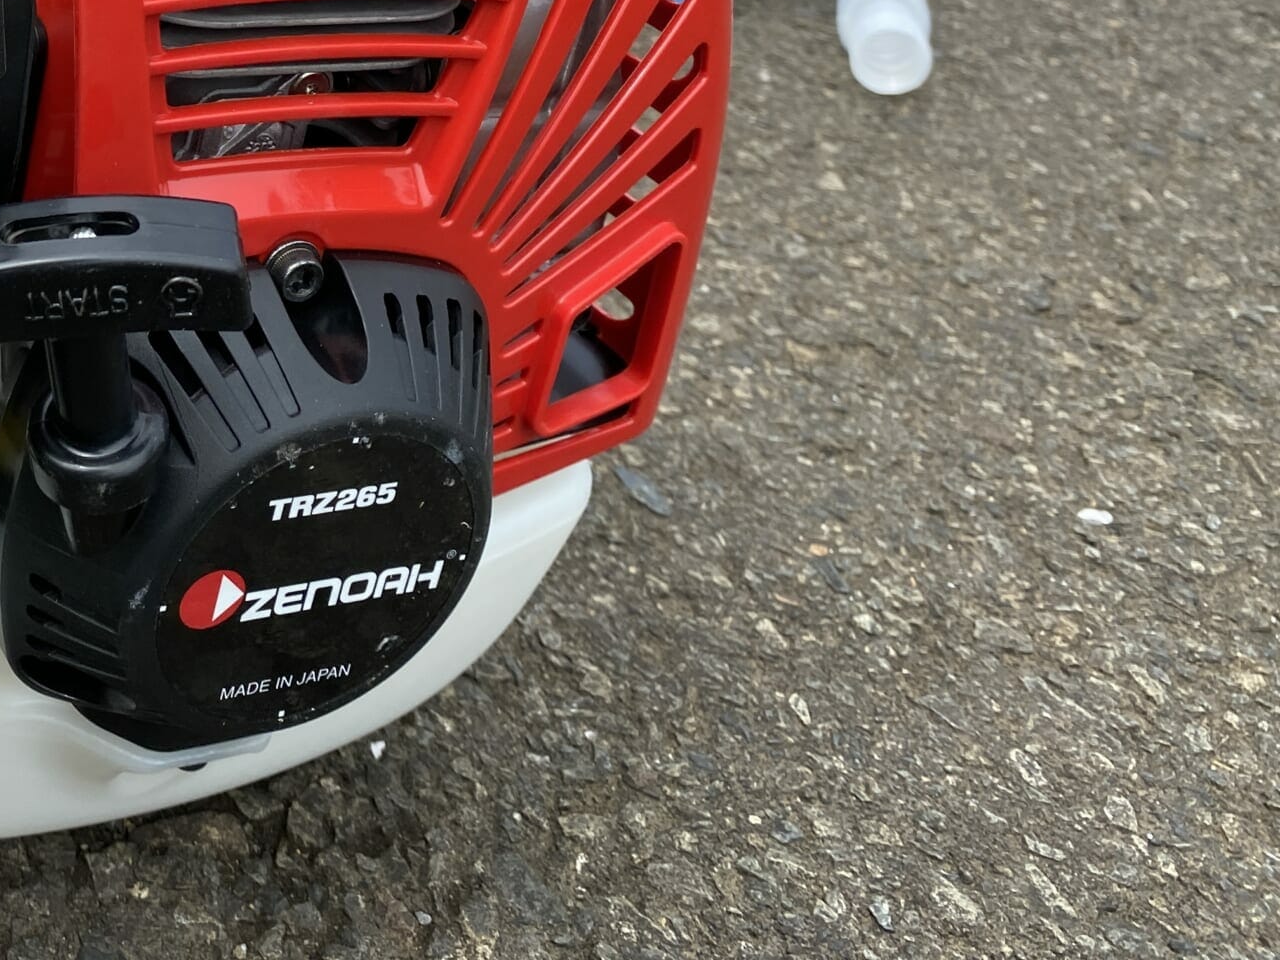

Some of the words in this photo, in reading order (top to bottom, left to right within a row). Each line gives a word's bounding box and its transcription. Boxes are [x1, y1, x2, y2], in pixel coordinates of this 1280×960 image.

[24, 284, 129, 320] START
[269, 482, 398, 521] TRZ265
[240, 560, 445, 622] ZENOAH
[220, 678, 270, 701] MADE
[275, 674, 294, 690] IN
[296, 663, 352, 687] JAPAN
